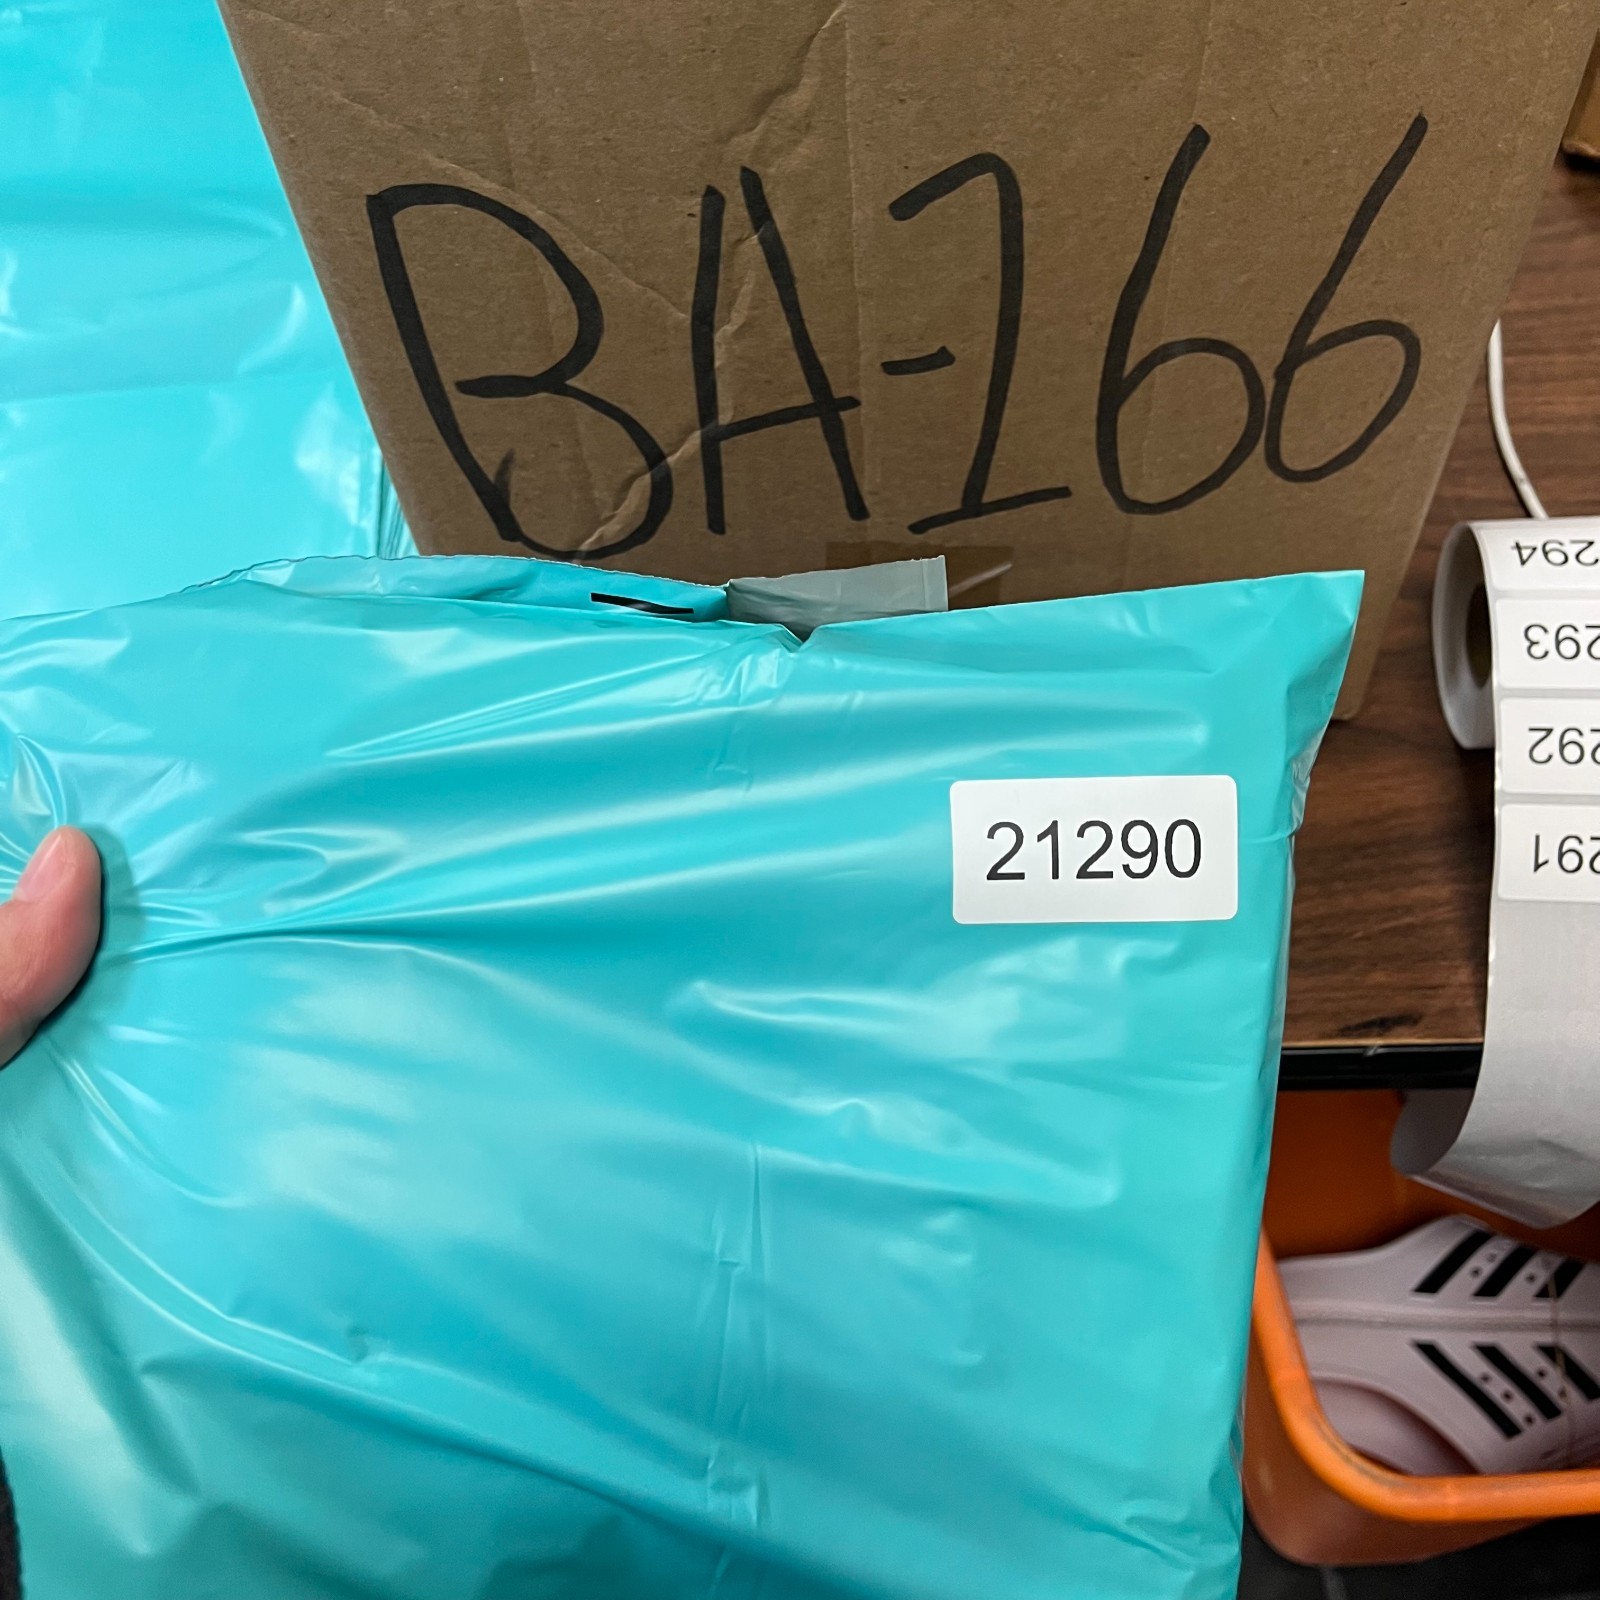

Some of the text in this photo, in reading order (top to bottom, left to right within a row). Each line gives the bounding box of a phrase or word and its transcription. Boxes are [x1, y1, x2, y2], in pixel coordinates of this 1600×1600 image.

[366, 115, 1426, 559] BA-166
[1512, 539, 1600, 567] 294
[986, 818, 1202, 881] 21290
